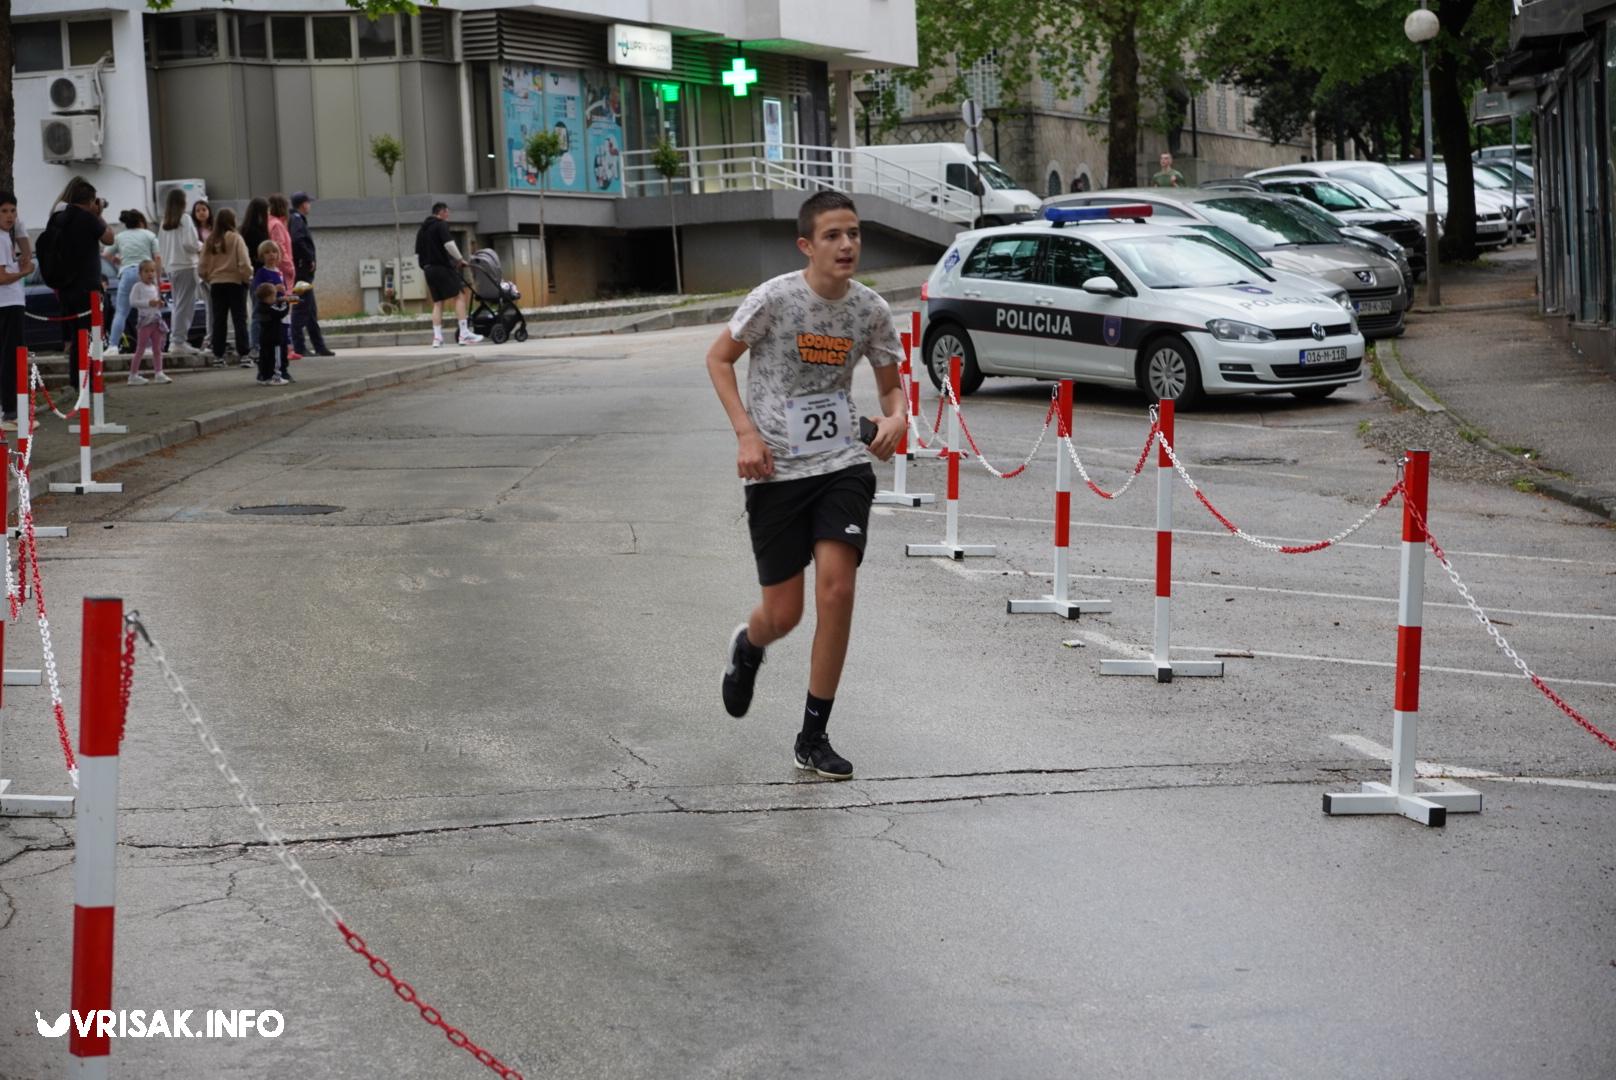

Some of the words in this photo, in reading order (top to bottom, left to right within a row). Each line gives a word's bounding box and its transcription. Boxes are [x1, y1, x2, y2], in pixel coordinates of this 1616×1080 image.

[996, 308, 1073, 336] POLICIJA
[797, 332, 854, 352] LOONEY
[799, 347, 848, 366] TUNES
[803, 410, 839, 442] 23
